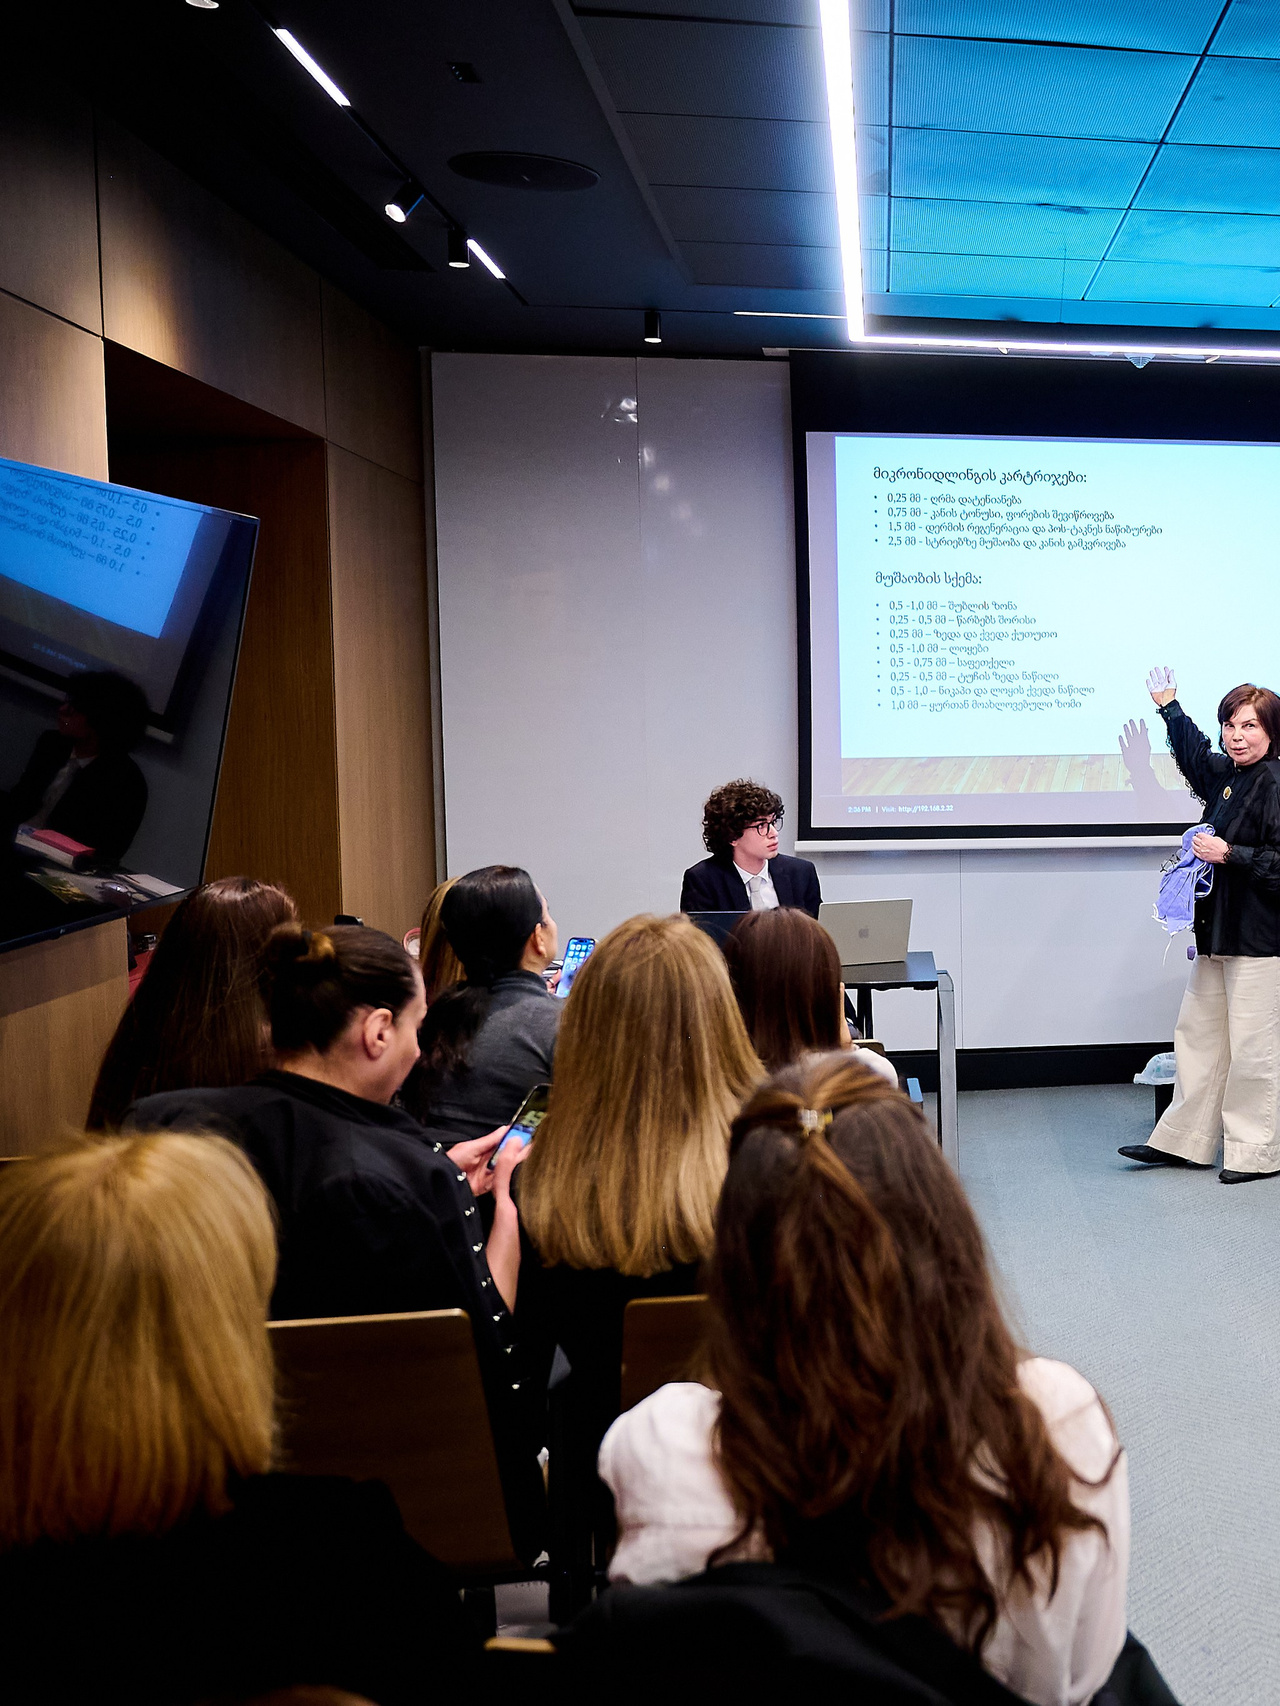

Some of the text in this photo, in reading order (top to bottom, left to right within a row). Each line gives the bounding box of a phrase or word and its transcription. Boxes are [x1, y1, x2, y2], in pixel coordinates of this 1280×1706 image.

[874, 466, 1087, 486] მიკრონიდლინგის კარტრიჯები:
[888, 493, 906, 504] 0,25
[910, 493, 921, 502] მმ
[930, 494, 956, 505] ღრმა
[958, 495, 1022, 507] დატენიანება
[888, 507, 906, 518] 0,75
[910, 507, 921, 517] მმ
[930, 508, 957, 520] კანის
[1006, 510, 1050, 521] ფორების
[1052, 510, 1114, 522] შევიწროვება
[889, 522, 902, 532] 1,5
[904, 522, 916, 532] მმ
[926, 522, 964, 534] დერმის
[967, 523, 1029, 535] რეგენერაცია
[1032, 526, 1046, 535] და
[1105, 524, 1162, 536] ნაწიბურები
[888, 536, 902, 547] 2,5
[904, 536, 916, 546] მმ
[926, 537, 977, 549] სტრიებზე
[979, 537, 1020, 549] მუშაობა
[1023, 540, 1036, 549] და
[1039, 538, 1065, 550] კანის
[1068, 539, 1126, 550] გამკვრივება
[876, 571, 982, 588] მუშაობის სქემა:
[889, 601, 903, 611] 0,5
[927, 601, 938, 610] მმ
[948, 601, 989, 613] შუბლის
[992, 601, 1017, 610] ზონა
[890, 615, 908, 625] 0,25
[918, 615, 932, 625] 0,5
[935, 615, 946, 624] მმ
[999, 615, 1036, 625] შორისი
[890, 629, 909, 639] 0,25
[912, 629, 923, 638] მმ
[933, 629, 961, 641] ზედა
[964, 632, 977, 641] და
[980, 629, 1009, 641] ქვედა
[1012, 629, 1058, 641] ქუთუთო
[890, 643, 904, 654] 0,5
[927, 643, 938, 653] მმ
[949, 644, 989, 655] ლოყები
[890, 658, 904, 668] 0,5
[914, 658, 932, 668] 0,75
[936, 658, 947, 667] მმ
[957, 657, 1015, 669] საფეთქელი
[890, 672, 909, 682] 0,25
[919, 672, 933, 682] 0,5
[936, 672, 947, 681] მმ
[958, 672, 990, 683] ტუჩის
[993, 671, 1019, 683] ზედა
[1022, 671, 1059, 683] ნაწილი
[891, 686, 904, 696] 0,5
[915, 686, 928, 696] 1,0
[939, 686, 971, 697] ნიკაპი
[974, 689, 988, 697] და
[990, 685, 1024, 697] ლოყის
[1027, 685, 1055, 697] ქვედა
[1058, 685, 1095, 696] ნაწილი
[892, 700, 904, 710] 1,0
[907, 700, 918, 710] მმ
[929, 700, 969, 712] ყურთან
[971, 700, 1052, 711] მოახლოვებული
